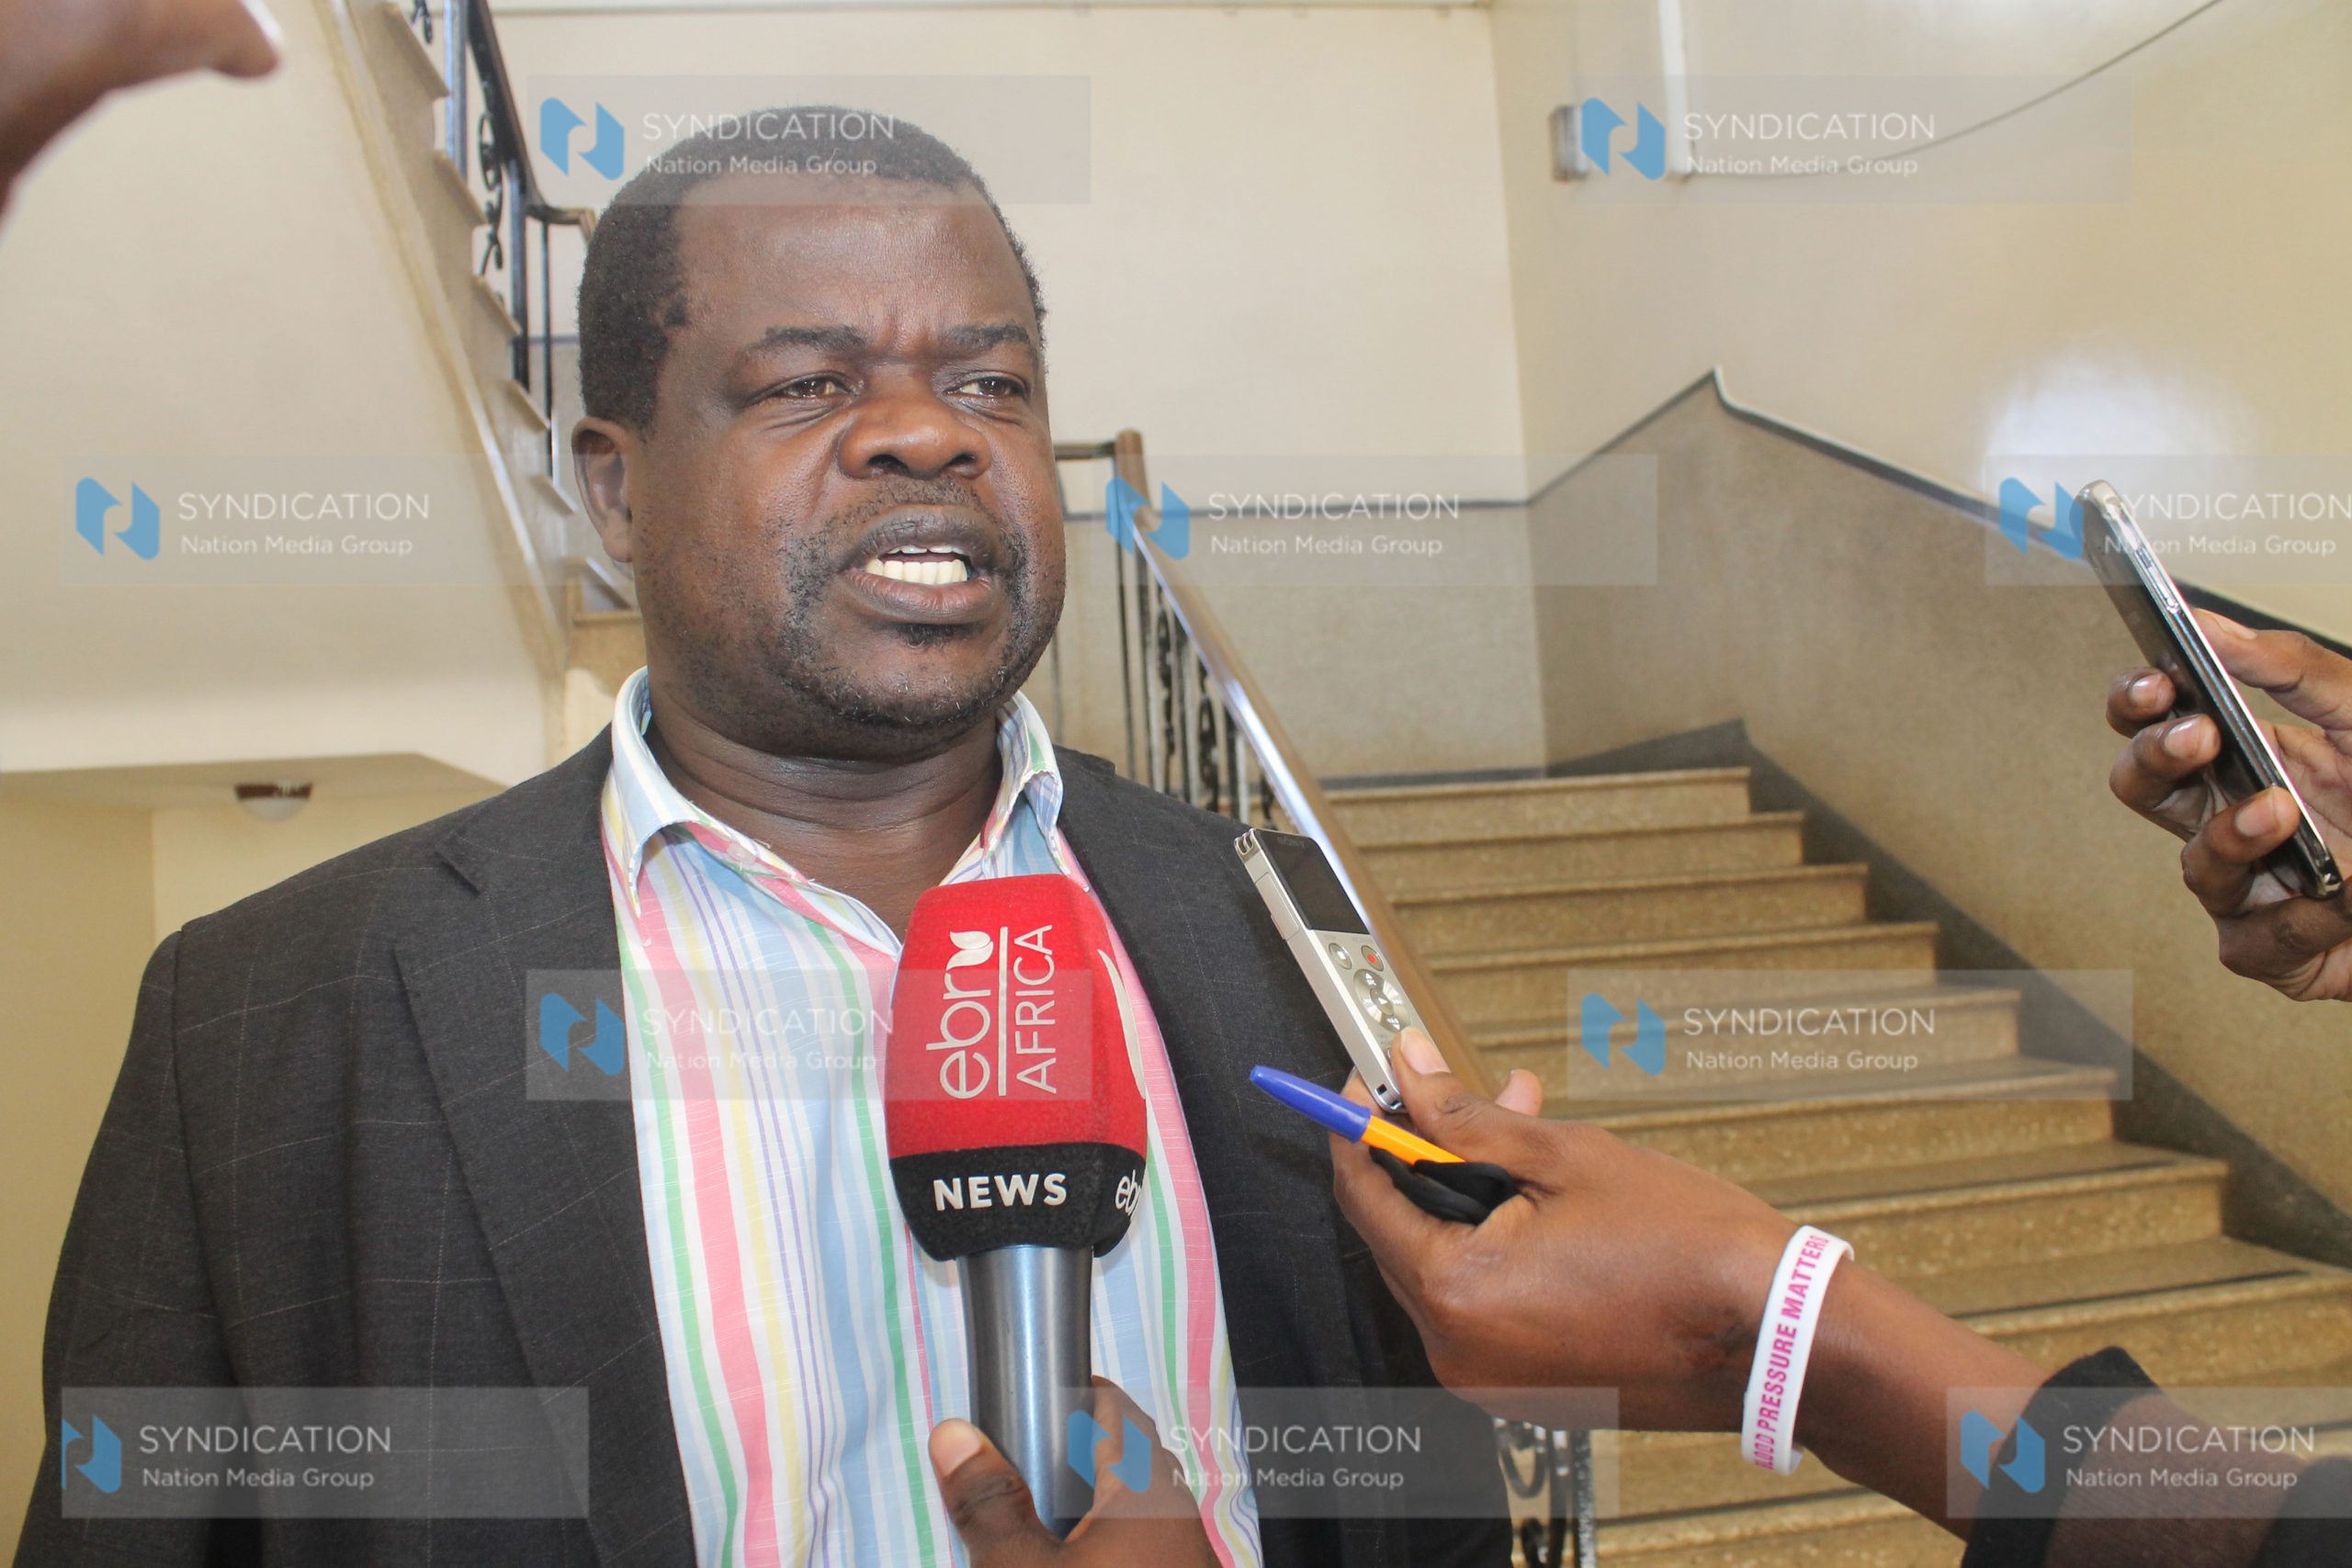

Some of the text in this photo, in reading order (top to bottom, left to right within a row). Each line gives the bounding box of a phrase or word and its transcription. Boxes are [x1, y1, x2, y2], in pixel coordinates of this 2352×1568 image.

[1013, 924, 1057, 1094] AFRICA
[933, 1173, 1068, 1212] NEWS
[1757, 1324, 1797, 1433] PRESSURE
